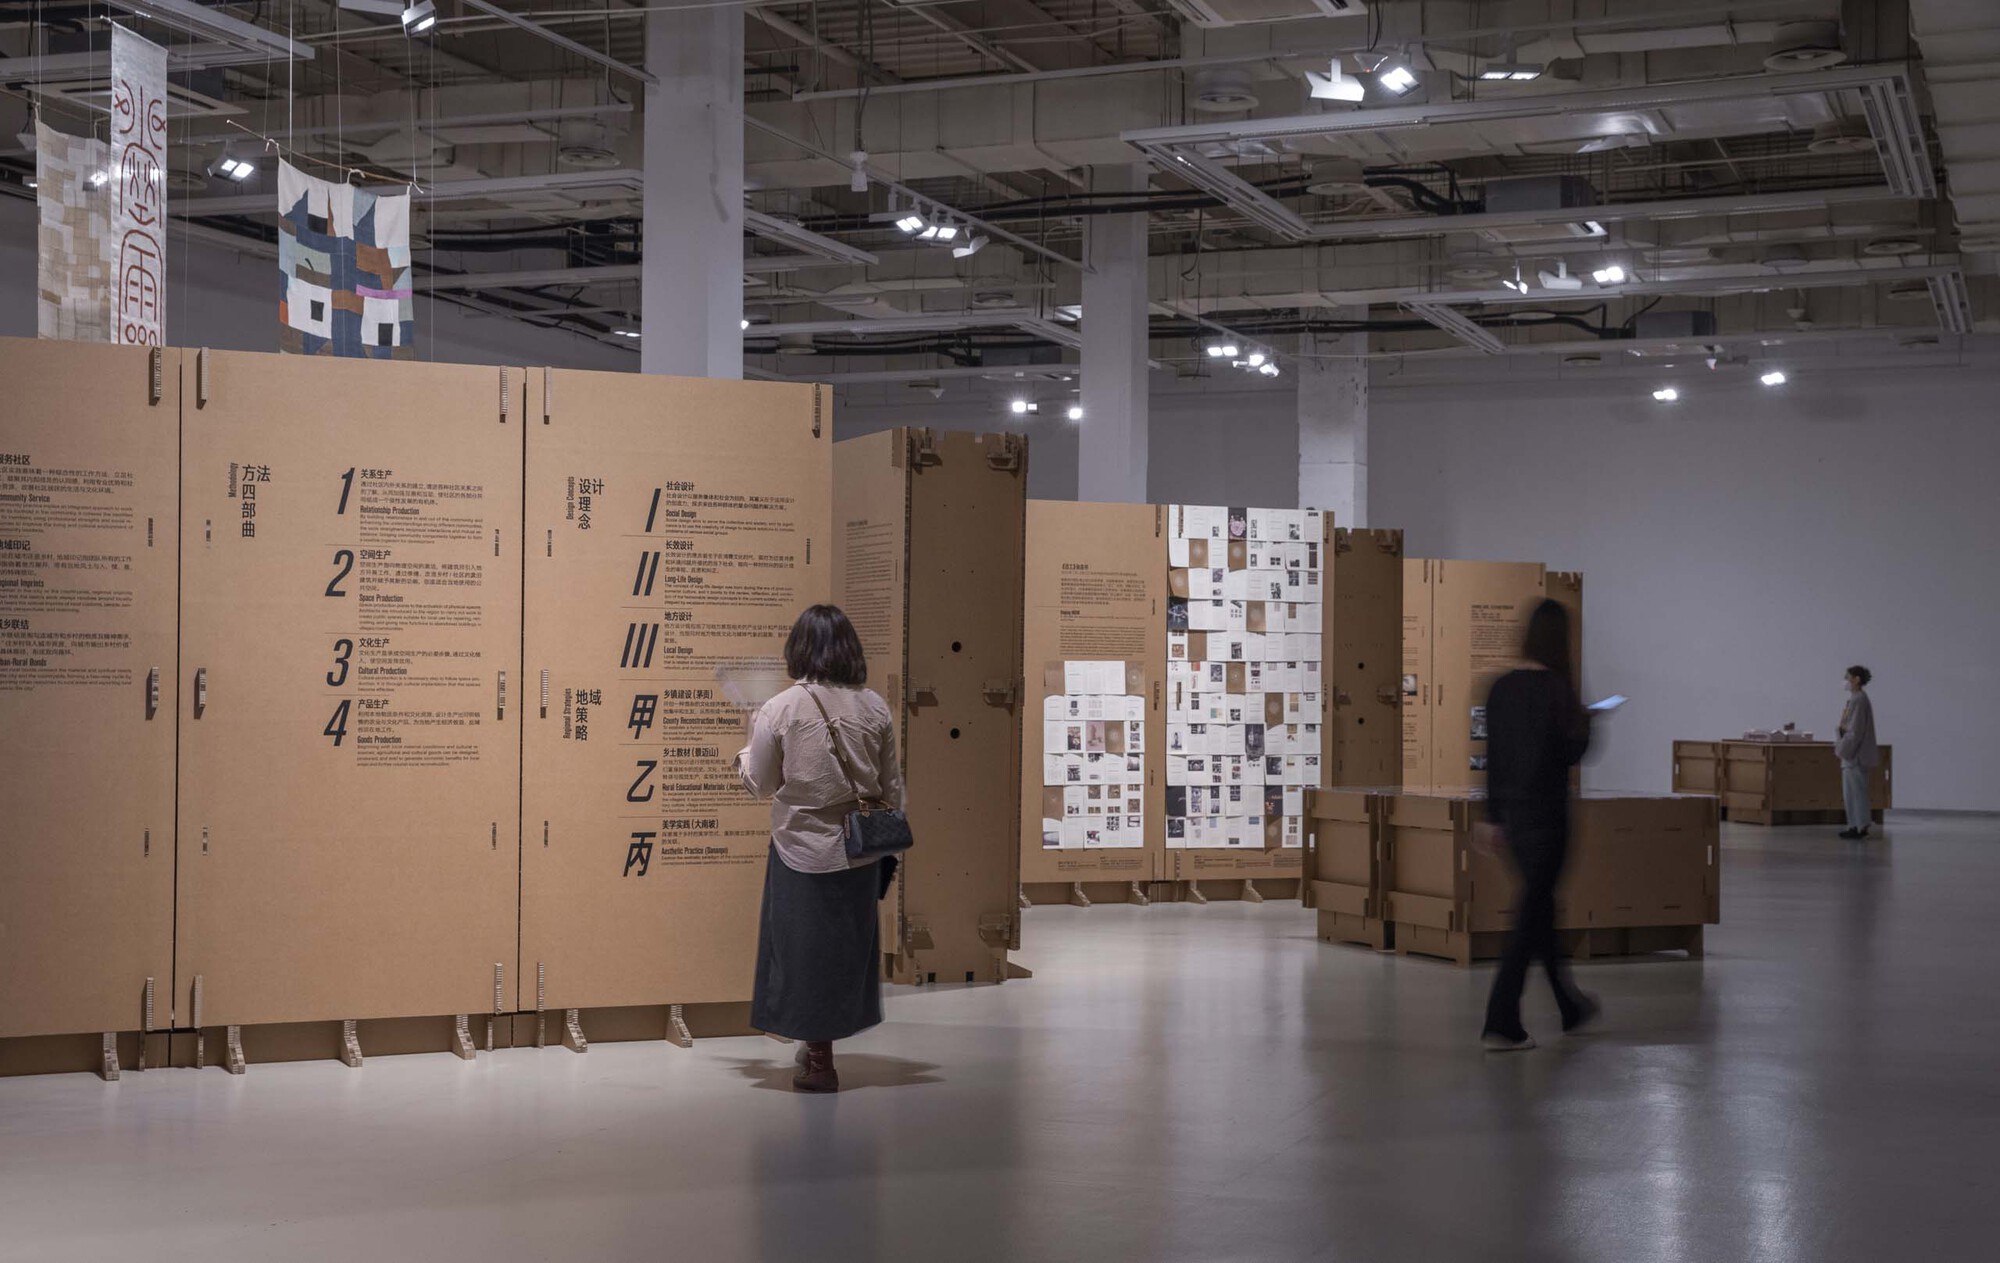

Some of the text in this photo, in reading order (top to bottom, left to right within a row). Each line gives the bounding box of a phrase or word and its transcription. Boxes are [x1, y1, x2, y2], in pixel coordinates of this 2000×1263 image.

[361, 468, 392, 479] 关系生产
[337, 467, 355, 514] 1
[666, 481, 694, 491] 社会设计
[29, 494, 50, 502] Service
[360, 506, 419, 515] Relationship Production
[666, 510, 696, 518] Social Design
[666, 541, 693, 550] 长效设计
[360, 550, 391, 559] 空间生产
[325, 549, 354, 597] 2
[21, 578, 44, 587] Imprints
[665, 575, 703, 584] Long-Life Design
[359, 594, 403, 602] Space Production
[664, 612, 692, 621] 地方设计
[0, 619, 29, 630] 乡联结
[359, 638, 389, 648] 文化生产
[664, 646, 676, 654] Local
[327, 639, 354, 687] 3
[358, 699, 389, 709] 产品生产
[627, 694, 658, 740] 甲
[324, 700, 351, 746] 4
[626, 760, 657, 803] 乙
[662, 783, 674, 791] Rural
[676, 783, 702, 791] Educational
[623, 832, 656, 877] 丙
